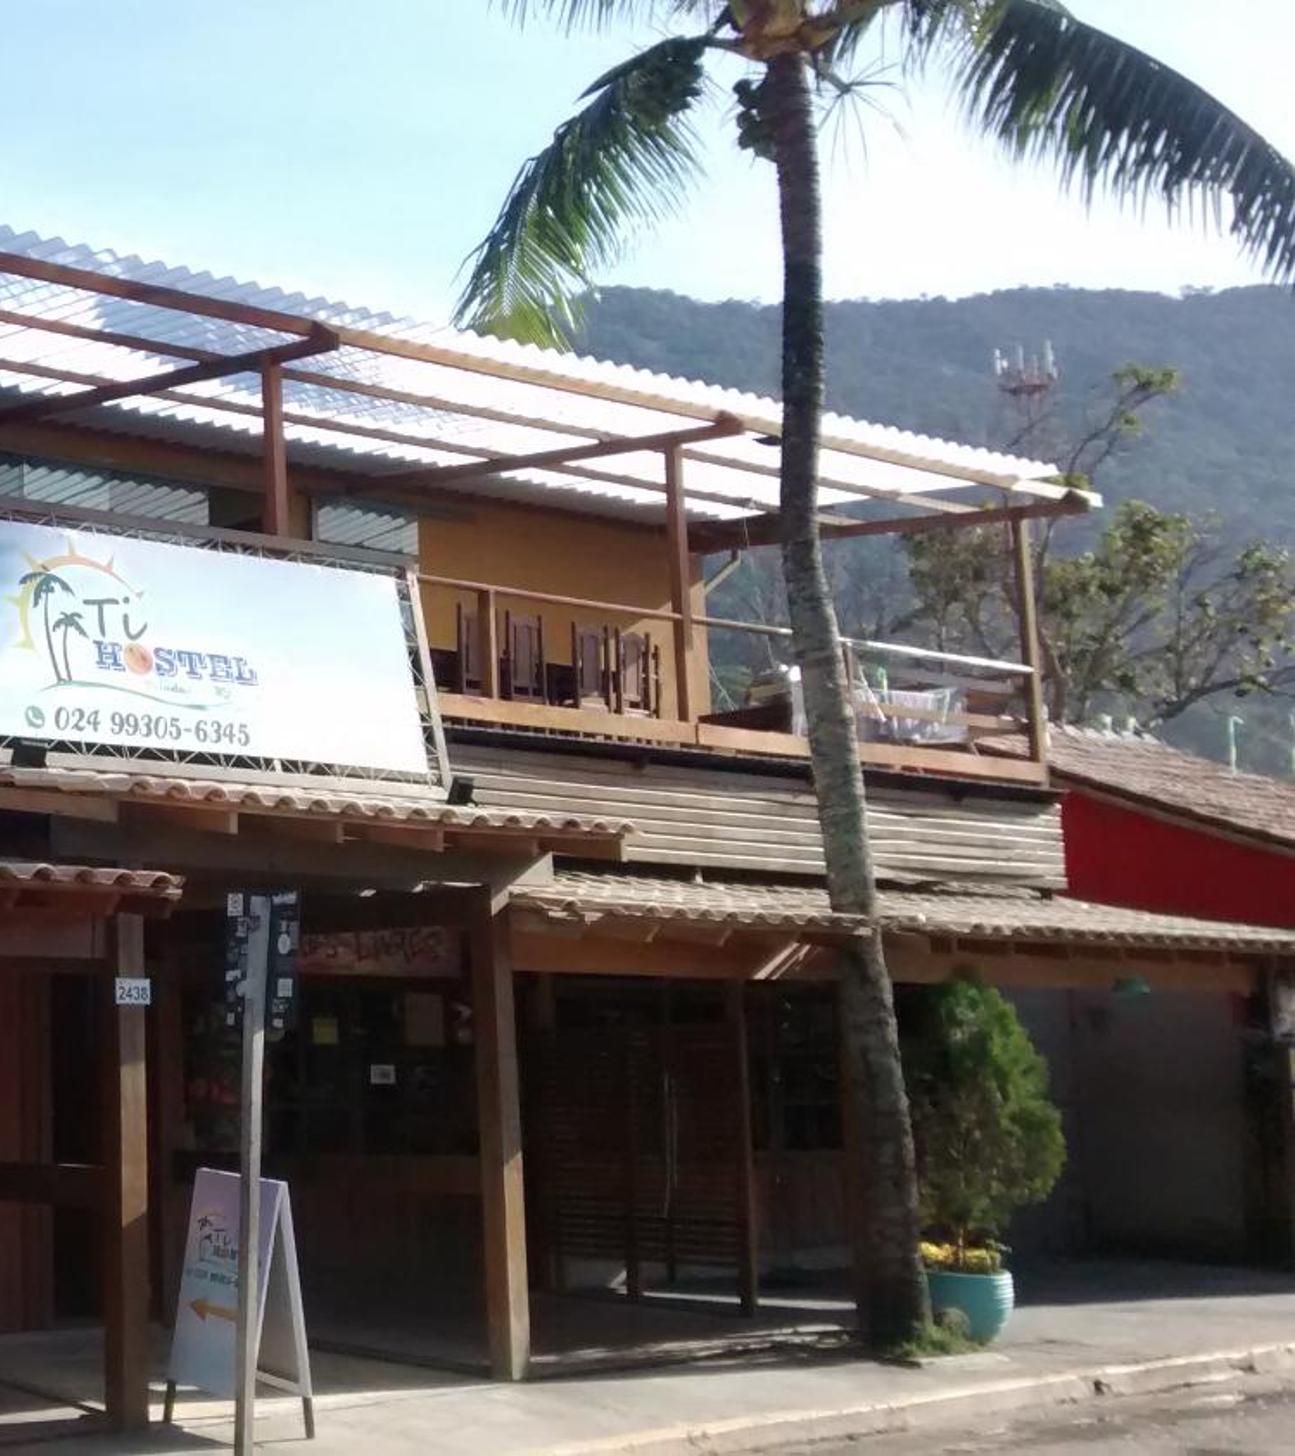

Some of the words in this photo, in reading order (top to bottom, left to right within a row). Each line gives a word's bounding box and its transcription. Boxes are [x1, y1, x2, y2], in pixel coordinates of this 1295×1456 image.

[82, 596, 148, 641] Ti
[92, 639, 260, 686] HOSTEL
[54, 706, 101, 732] 024
[110, 711, 251, 746] 99305-6345
[118, 985, 149, 1001] 2438
